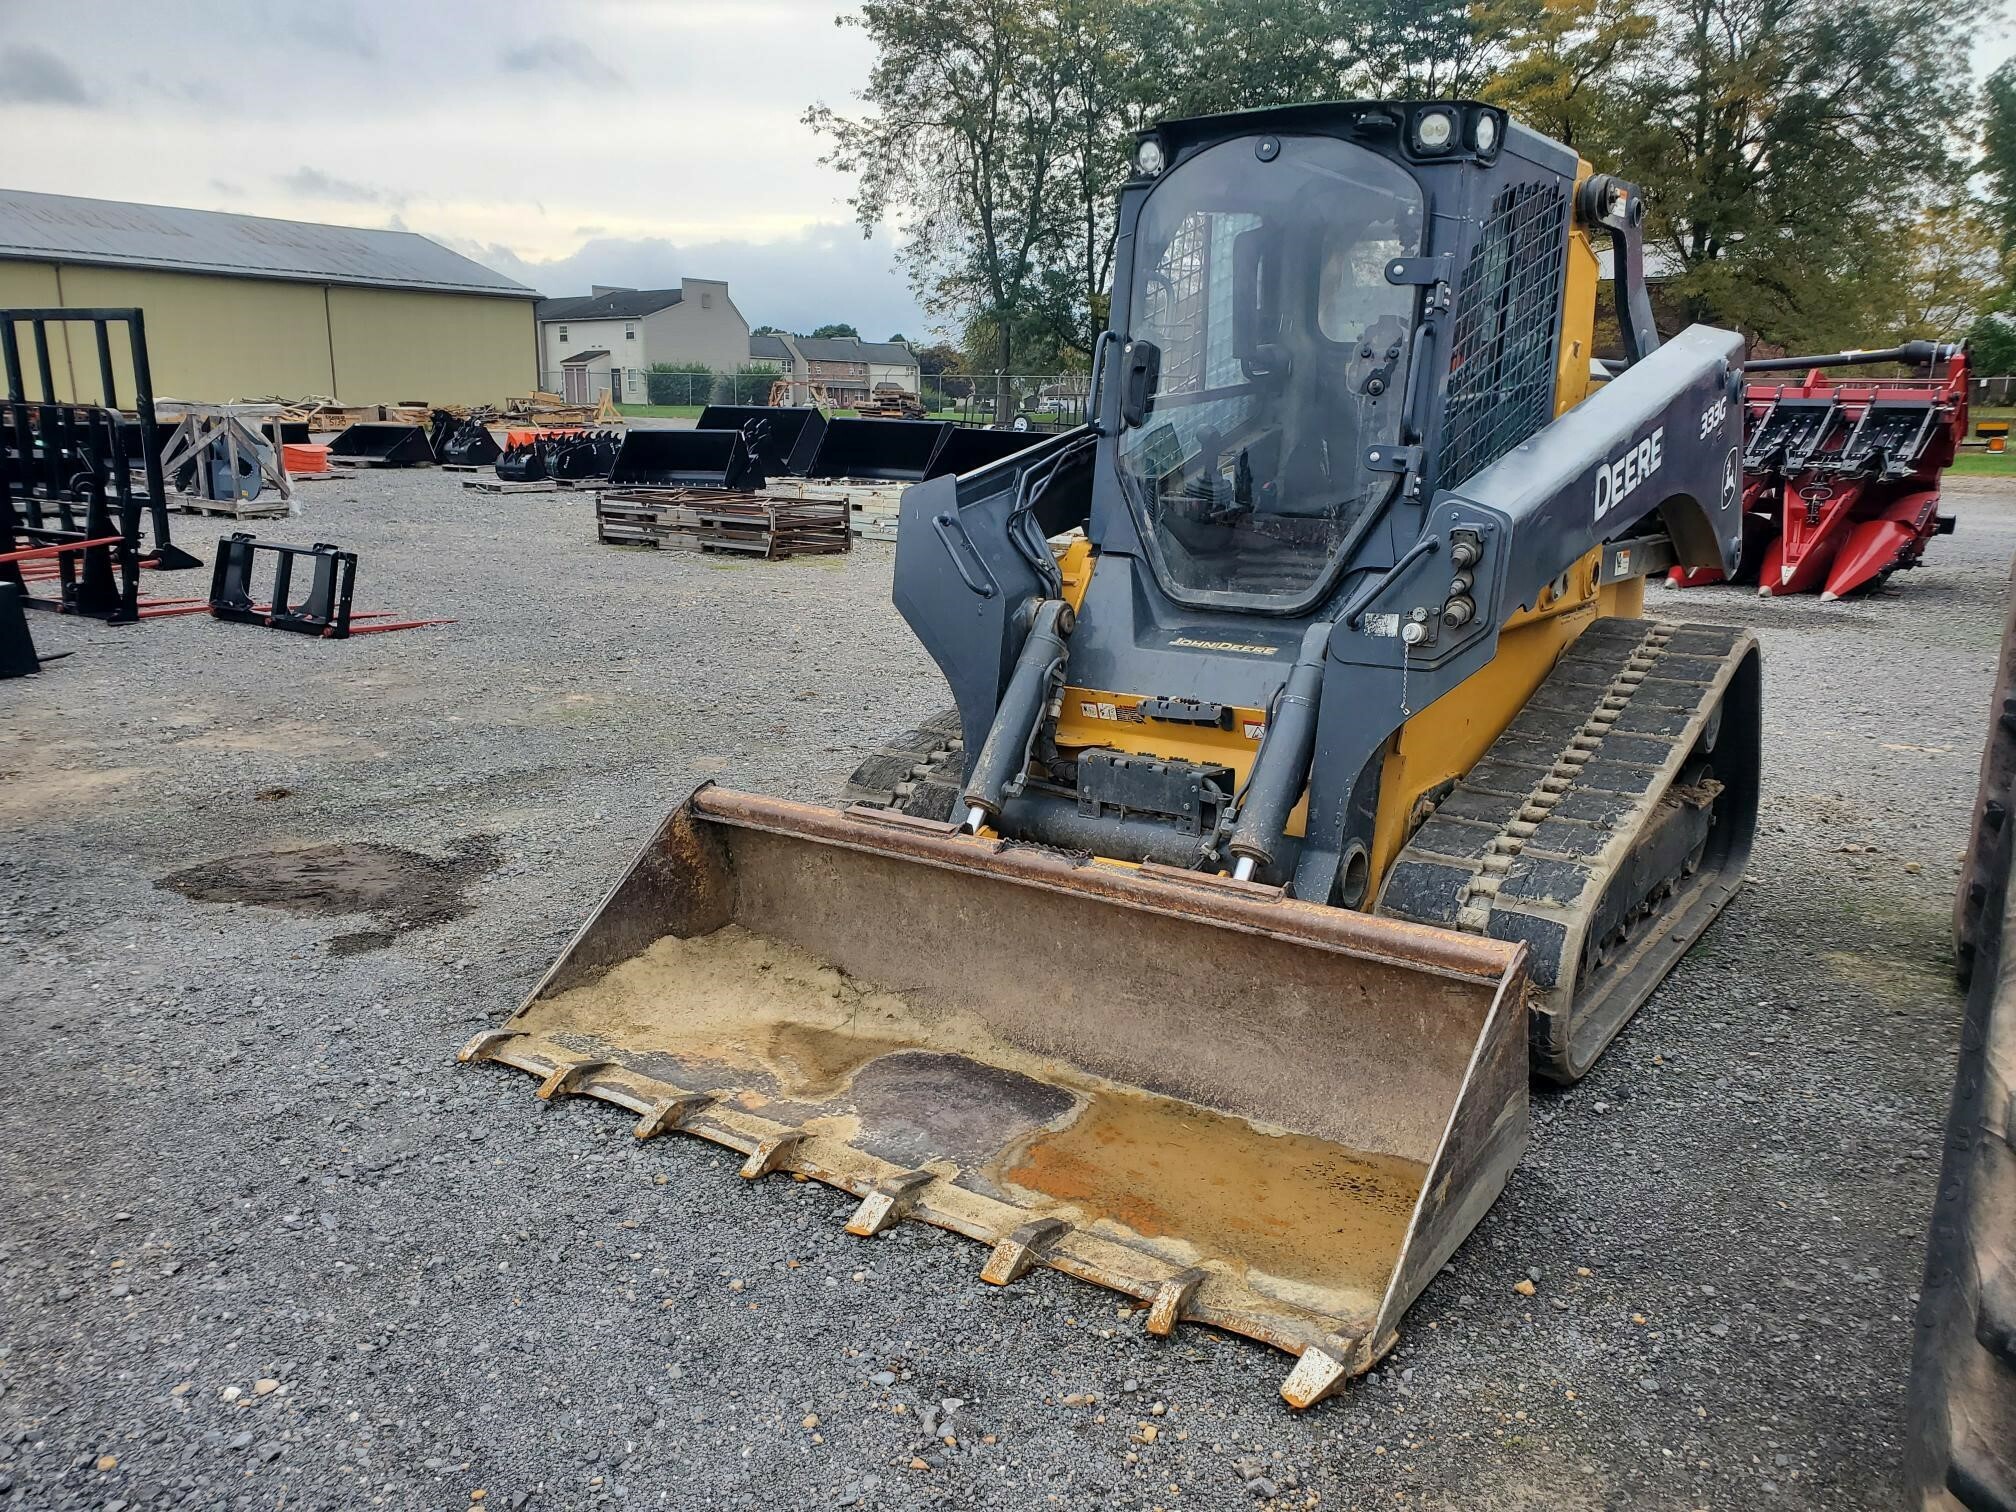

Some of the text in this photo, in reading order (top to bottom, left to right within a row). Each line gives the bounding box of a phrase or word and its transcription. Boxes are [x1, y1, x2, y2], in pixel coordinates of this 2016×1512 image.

[1700, 396, 1727, 440] 333G
[1594, 426, 1664, 523] DEERE
[1168, 637, 1280, 656] JOHN DEERE
